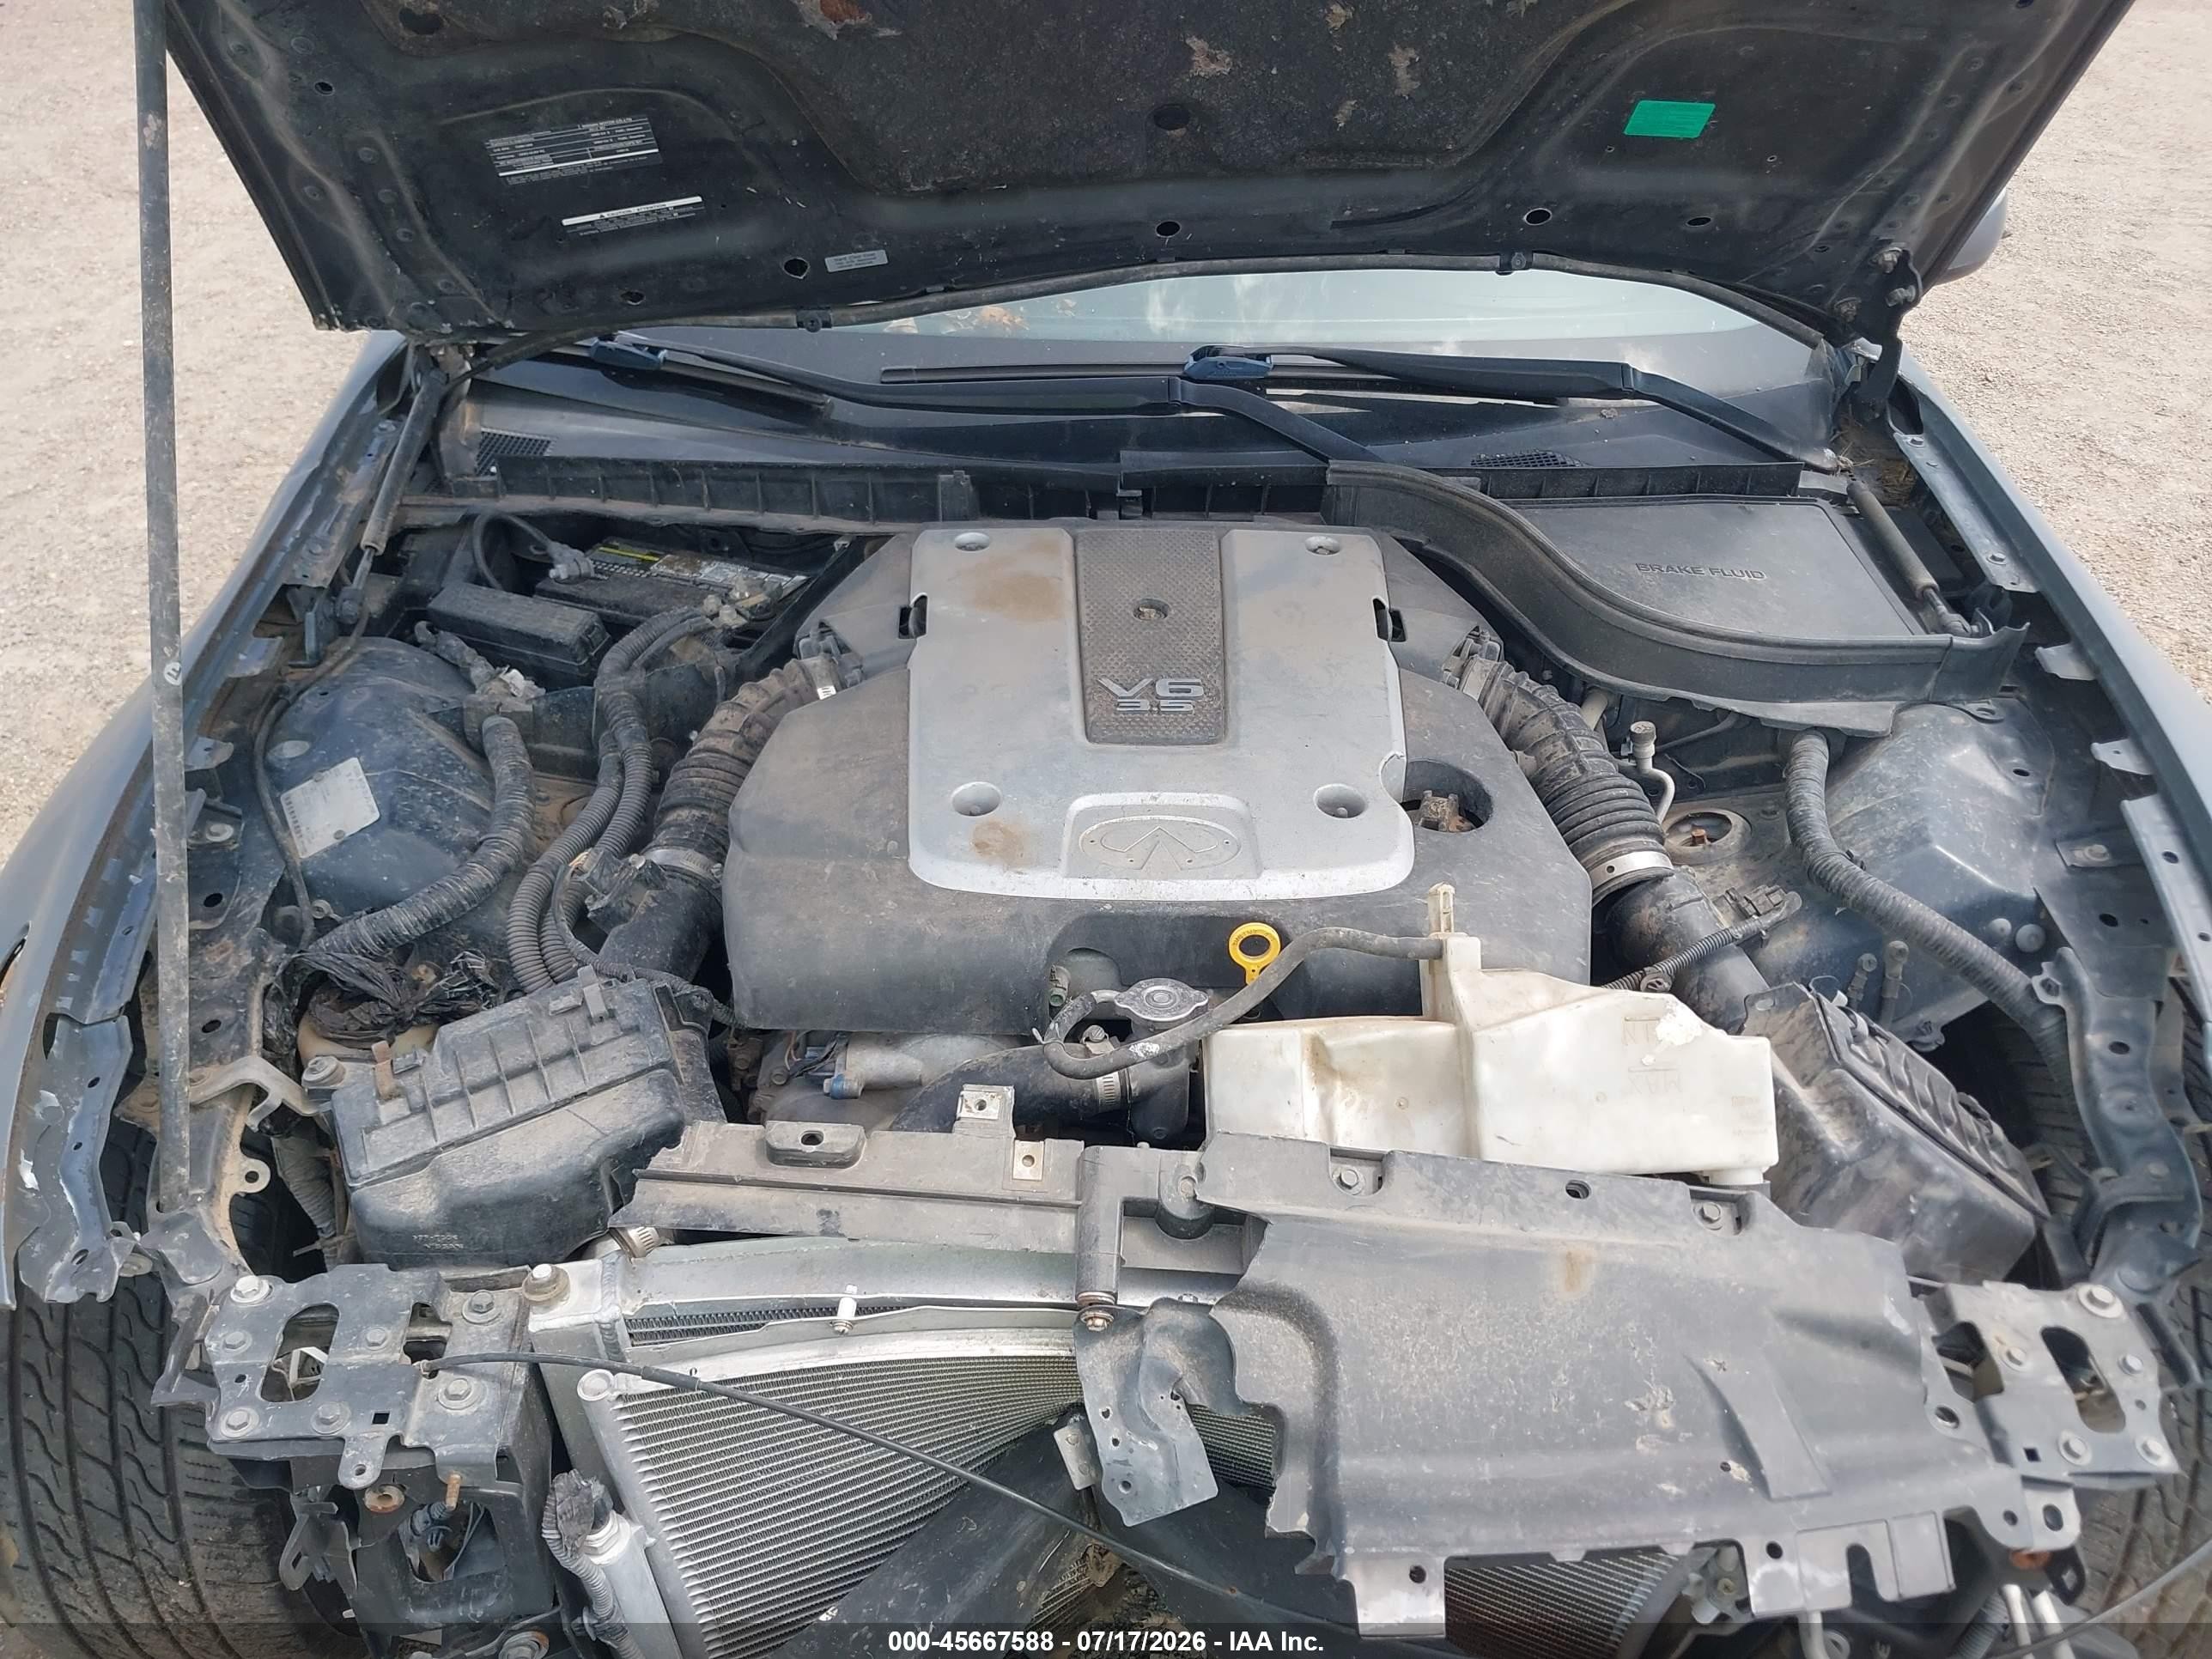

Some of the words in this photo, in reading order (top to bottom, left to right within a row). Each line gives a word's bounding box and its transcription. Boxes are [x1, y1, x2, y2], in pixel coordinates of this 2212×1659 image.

[1635, 562, 1705, 575] BRAKE
[1708, 567, 1768, 580] FLUID
[1097, 678, 1205, 700] V6
[1115, 699, 1195, 714] 3.5
